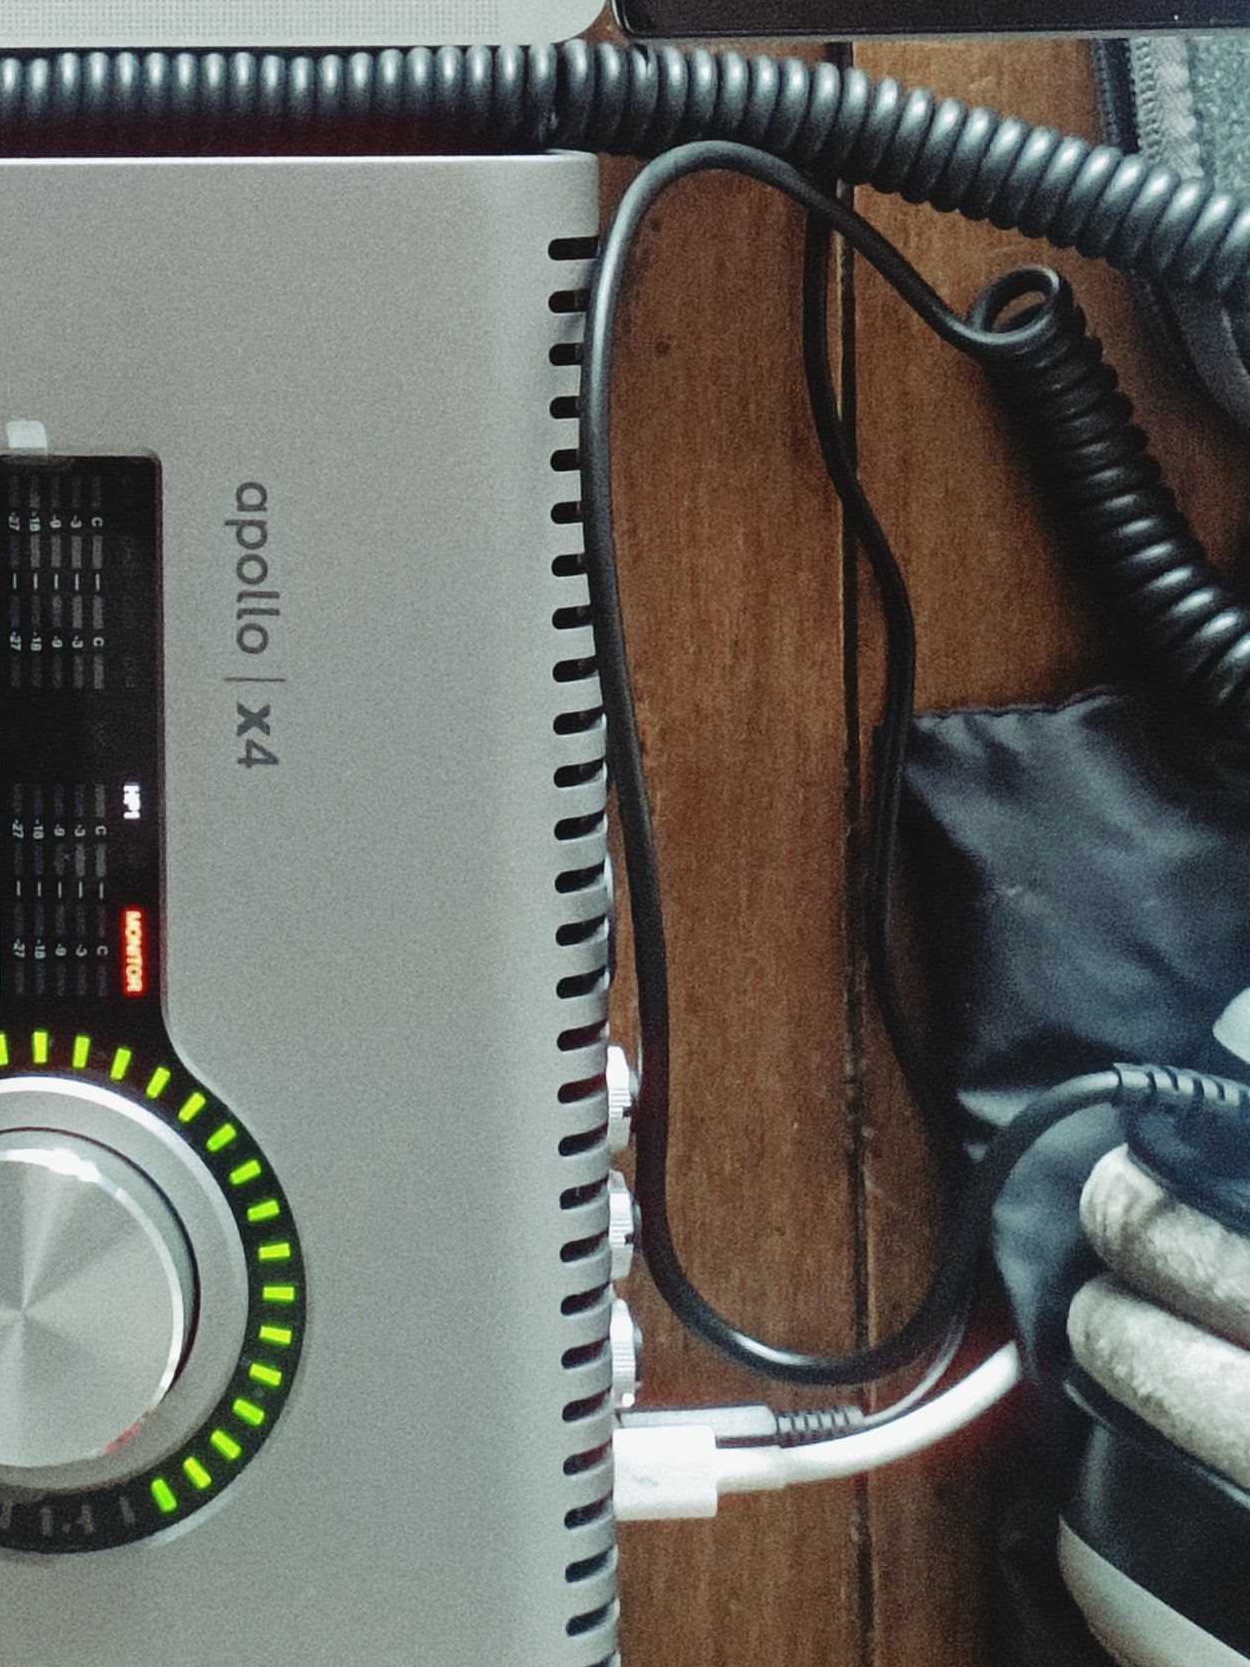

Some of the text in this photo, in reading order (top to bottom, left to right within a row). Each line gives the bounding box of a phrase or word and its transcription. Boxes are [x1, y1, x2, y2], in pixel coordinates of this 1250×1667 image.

[224, 481, 281, 769] apollo x4
[123, 785, 141, 819] HP1
[125, 911, 142, 992] MONITOR
